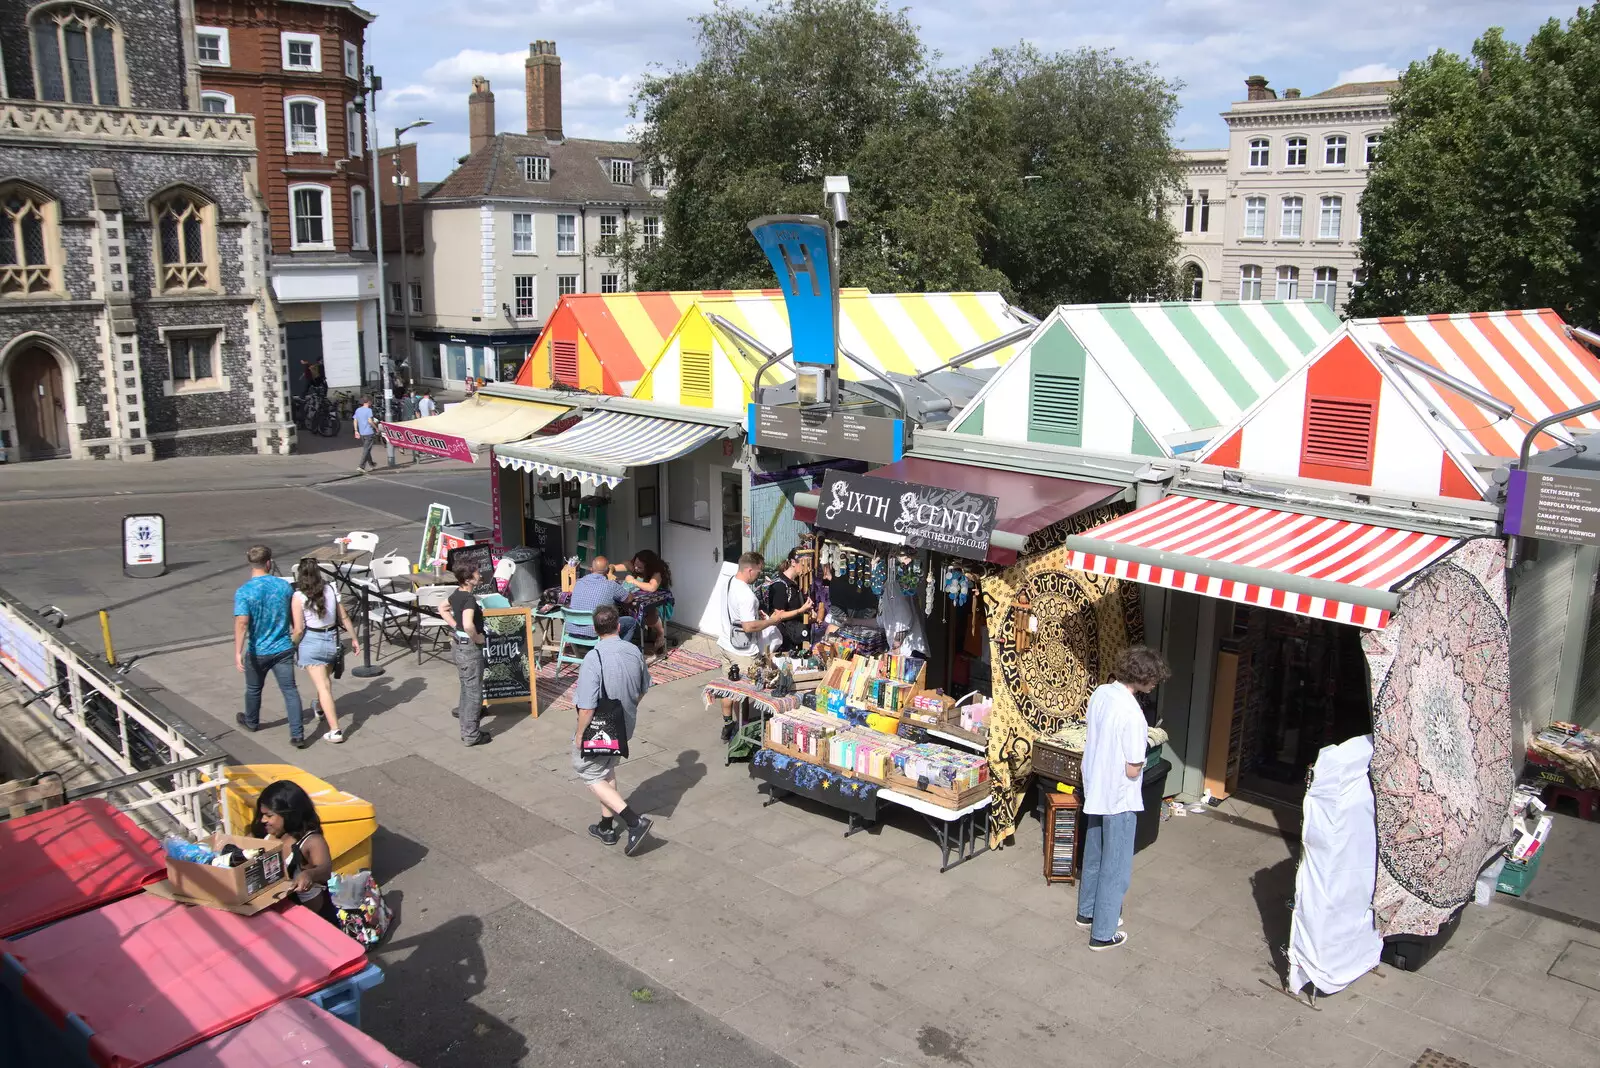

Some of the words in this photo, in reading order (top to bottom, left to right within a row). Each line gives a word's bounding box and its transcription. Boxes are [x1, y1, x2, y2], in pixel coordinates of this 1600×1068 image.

[778, 243, 820, 296] H
[384, 425, 404, 440] Ice
[405, 429, 448, 450] Cream
[825, 480, 891, 523] SIXTH
[893, 491, 982, 534] SCENTS
[1538, 500, 1565, 508] NORFOLK
[1537, 512, 1560, 520] CANARY
[1560, 516, 1582, 524] COMICS
[904, 527, 988, 550] WWW.SIXTHSCENTS.CO.UK
[1569, 529, 1596, 537] NORWICH
[482, 637, 521, 659] Henna
